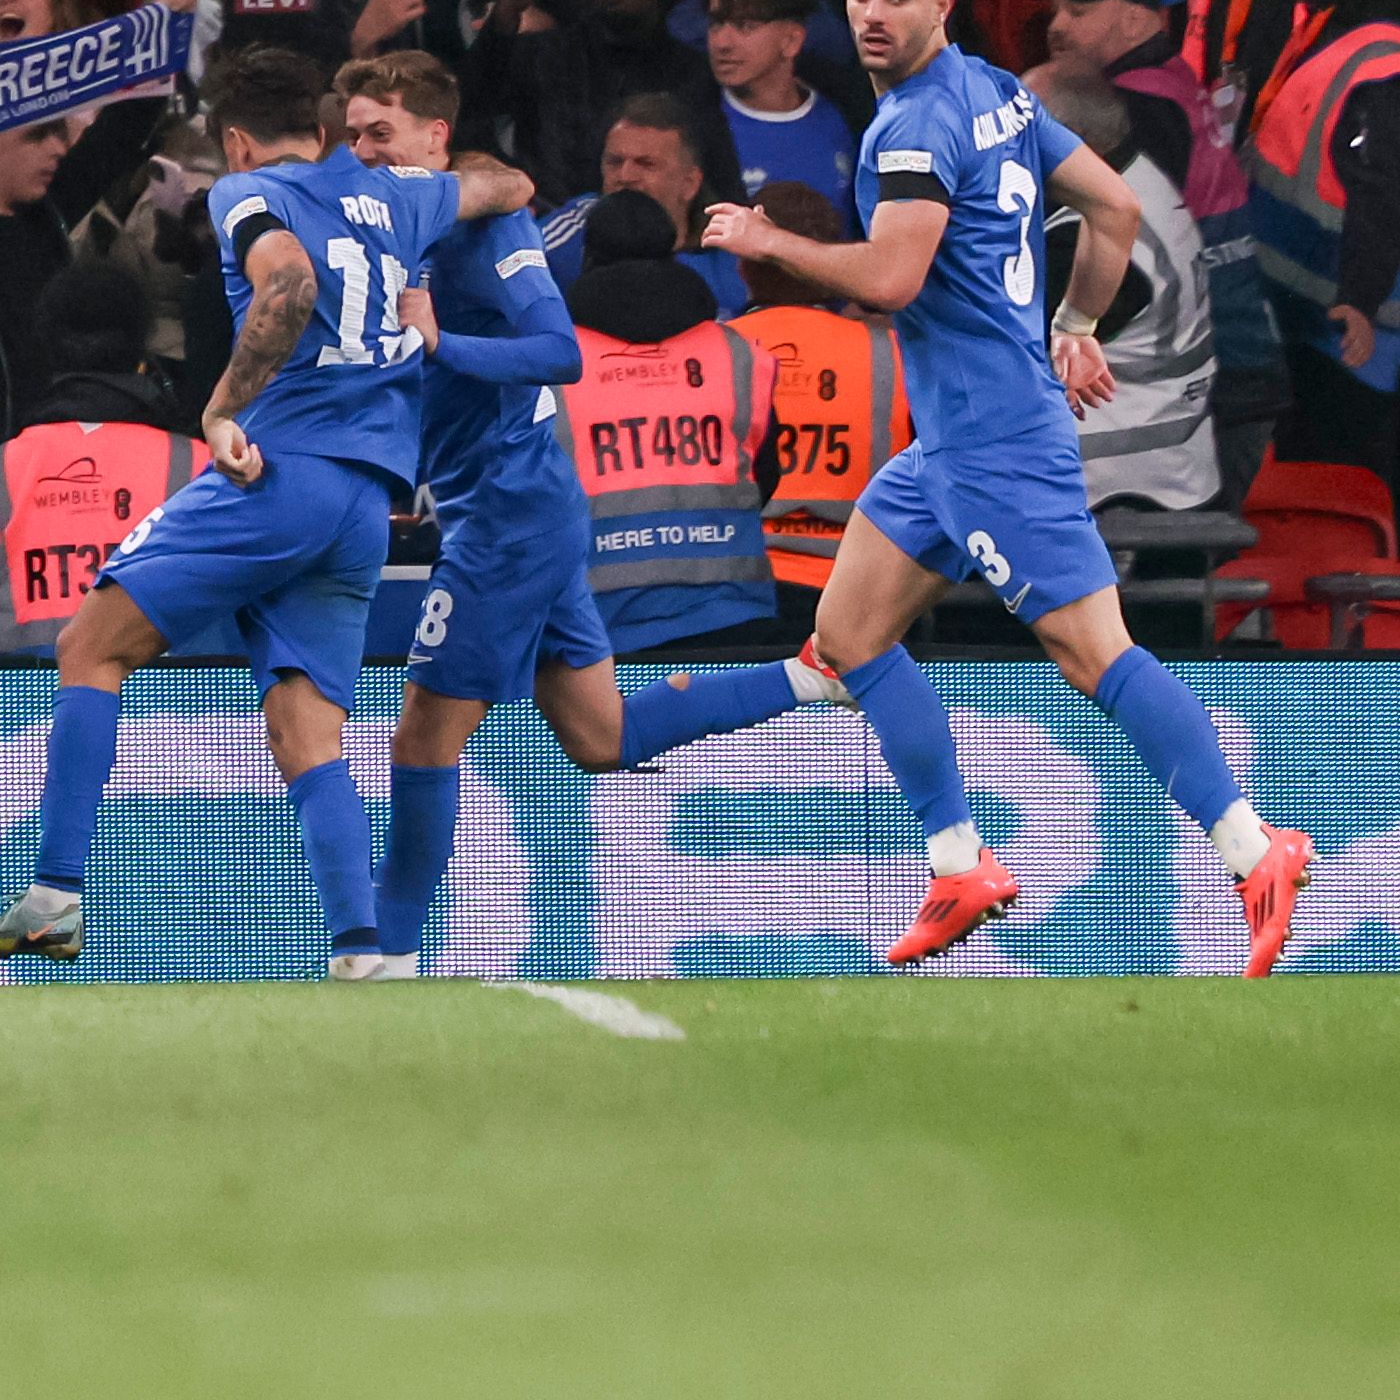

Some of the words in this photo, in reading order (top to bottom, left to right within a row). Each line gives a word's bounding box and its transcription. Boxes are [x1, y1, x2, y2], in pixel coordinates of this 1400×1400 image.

[997, 158, 1037, 306] 3
[596, 362, 678, 384] WEMBLEY
[775, 373, 811, 386] LEY
[589, 414, 722, 476] RT480
[34, 488, 110, 509] WEMBLEY
[119, 506, 165, 555] 5
[596, 530, 654, 553] HERE
[656, 526, 684, 545] TO
[687, 525, 736, 544] HELP
[24, 543, 120, 603] RT3
[966, 530, 1011, 587] 3
[420, 588, 454, 647] 8
